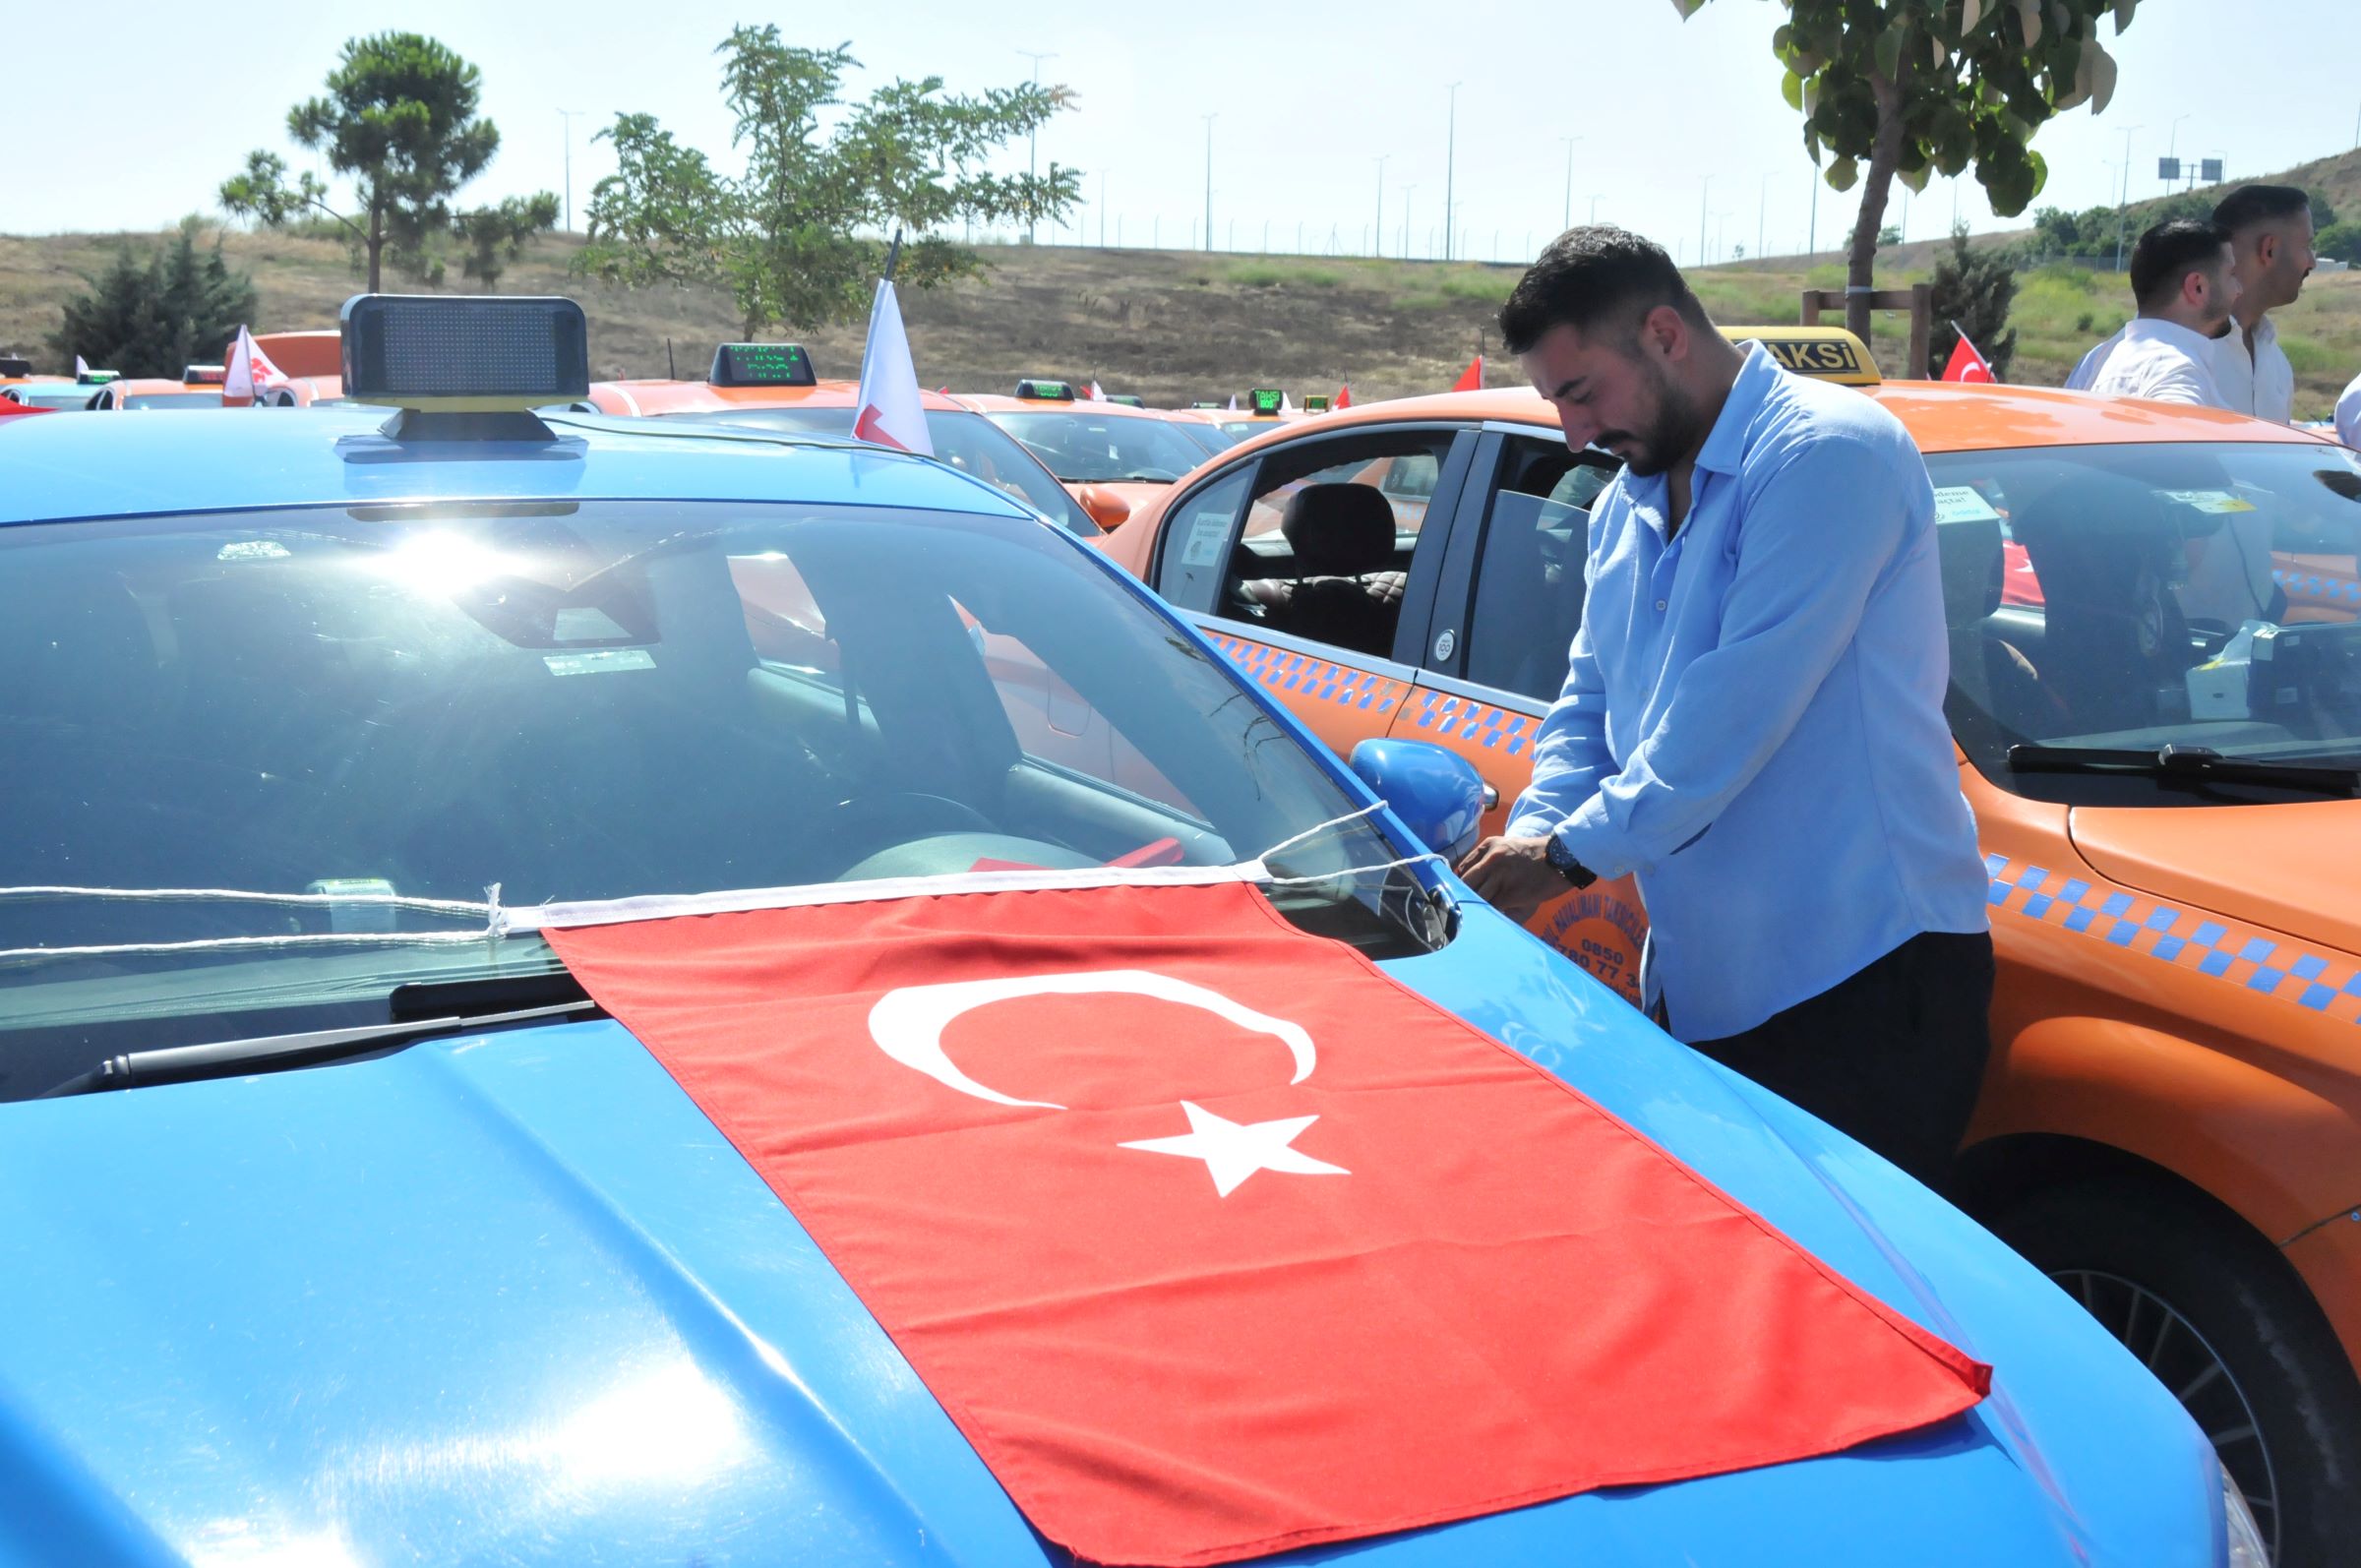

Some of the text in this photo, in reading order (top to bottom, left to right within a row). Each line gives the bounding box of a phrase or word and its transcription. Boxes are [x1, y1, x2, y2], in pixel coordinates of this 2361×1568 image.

[1767, 344, 1855, 368] AKSi
[1581, 938, 1624, 964] 0850
[1596, 959, 1620, 980] 77
[1626, 972, 1641, 989] 3
